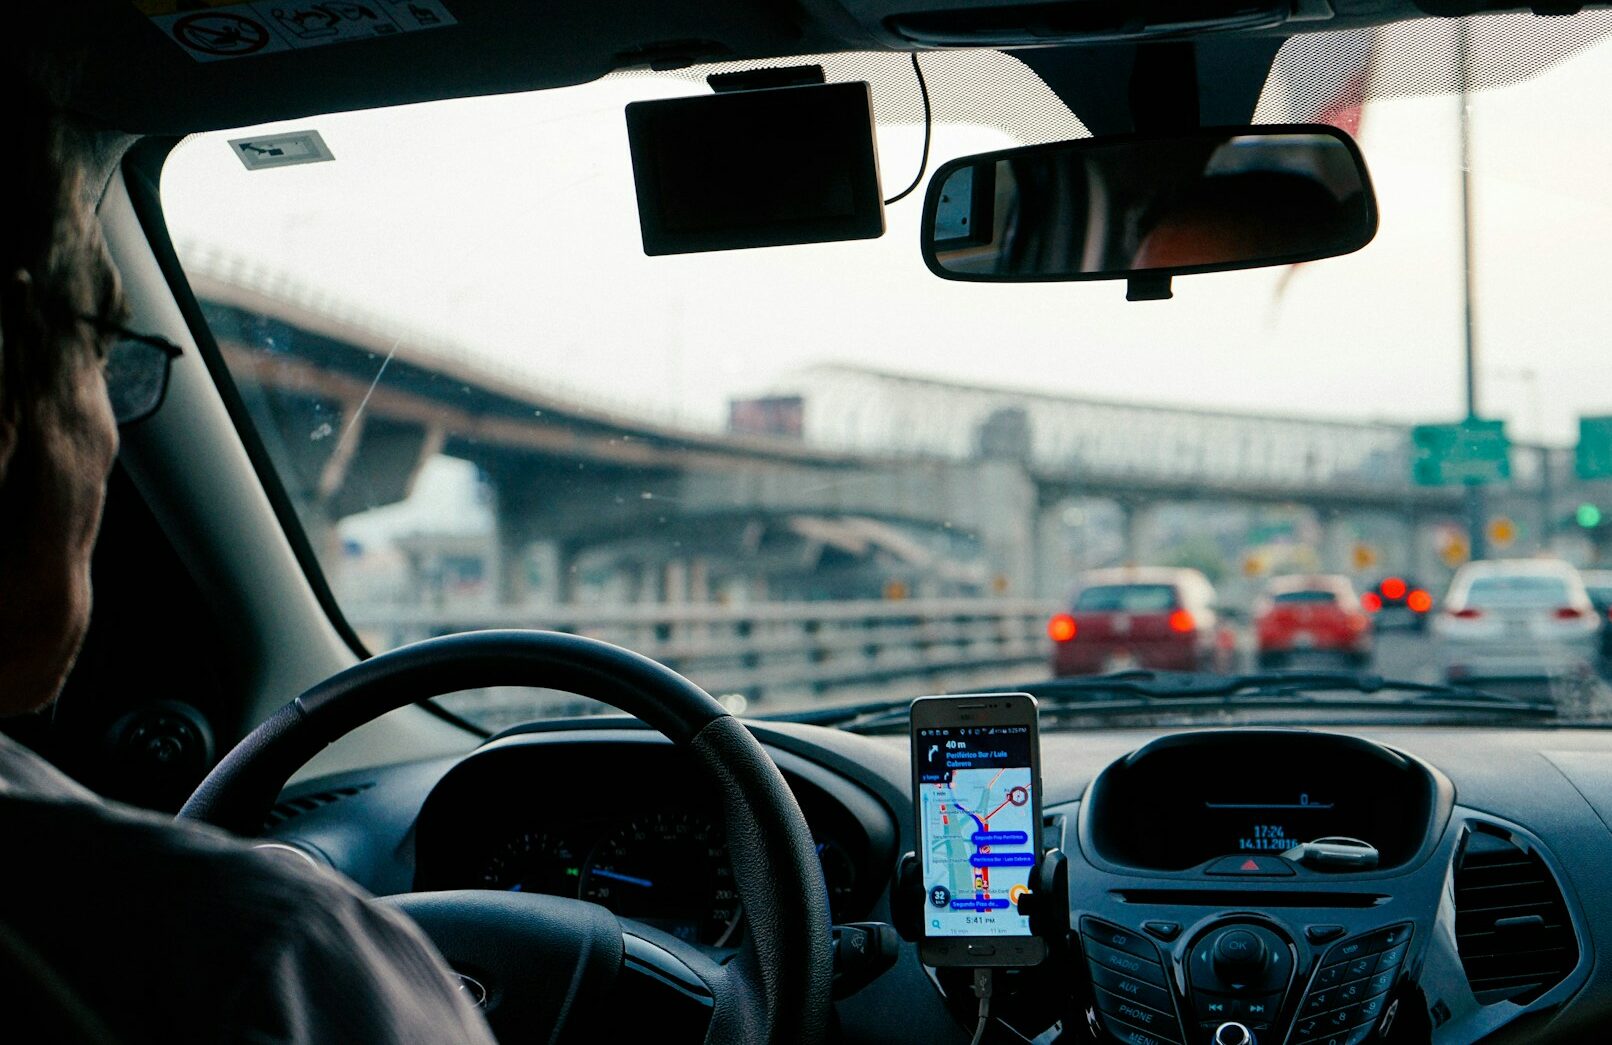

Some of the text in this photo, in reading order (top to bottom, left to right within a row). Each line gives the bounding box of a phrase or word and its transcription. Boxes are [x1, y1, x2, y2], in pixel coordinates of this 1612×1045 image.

[946, 740, 957, 749] 40
[1254, 824, 1284, 838] 17:24
[934, 890, 945, 900] 32
[1112, 935, 1127, 945] CD
[1229, 941, 1247, 951] OK
[1110, 955, 1139, 971] RADIO
[1119, 981, 1139, 994] AUX
[1119, 1004, 1153, 1024] PHONE
[1128, 1031, 1159, 1045] MENU
